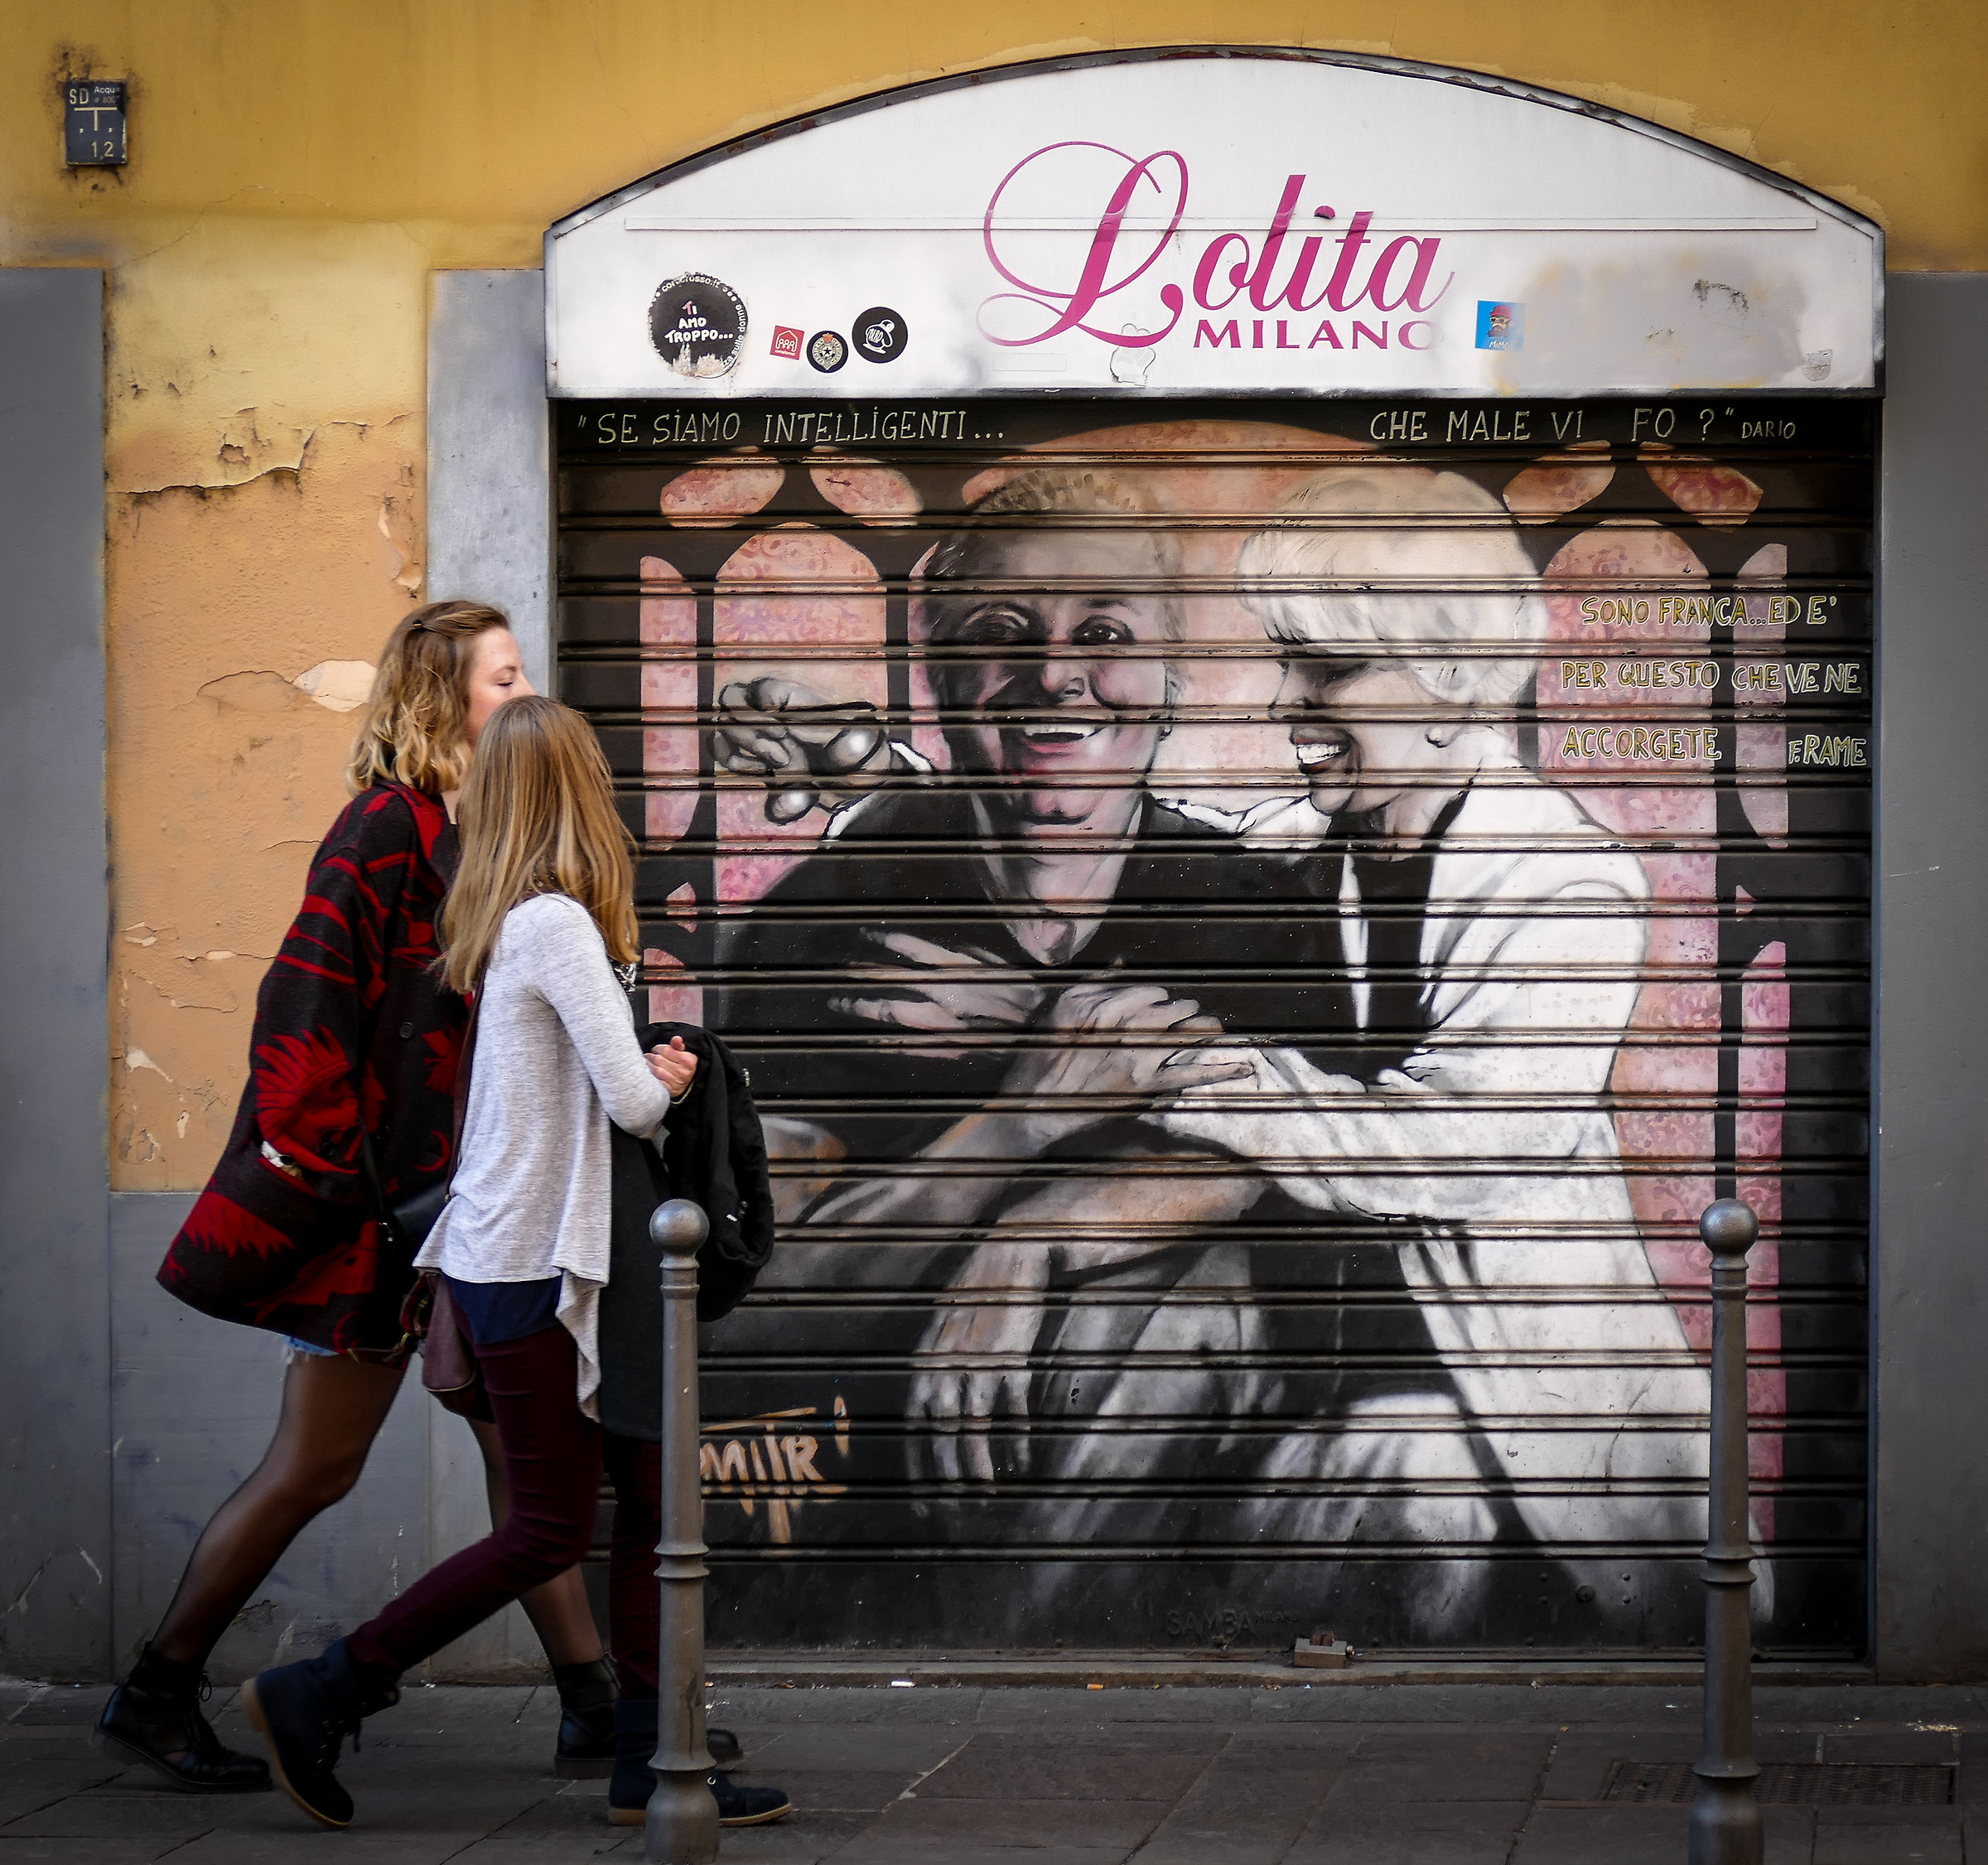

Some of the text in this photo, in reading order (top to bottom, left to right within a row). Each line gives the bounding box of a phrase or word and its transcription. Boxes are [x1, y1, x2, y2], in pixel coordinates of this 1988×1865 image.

[69, 89, 89, 104] SD
[975, 140, 1455, 349] Lolita
[664, 329, 734, 344] TROPPO...
[678, 316, 707, 330] AMO
[1193, 319, 1445, 351] MILANO
[1369, 410, 1429, 442] CHE
[1445, 409, 1530, 442] MALE
[1551, 409, 1583, 440] VI
[1631, 407, 1676, 442] FO
[1741, 421, 1797, 440] DARIO
[1581, 597, 1650, 626] SONO
[1561, 661, 1863, 693] PER QUESTO CHE VE NE
[1561, 726, 1722, 762] ACCORGETE
